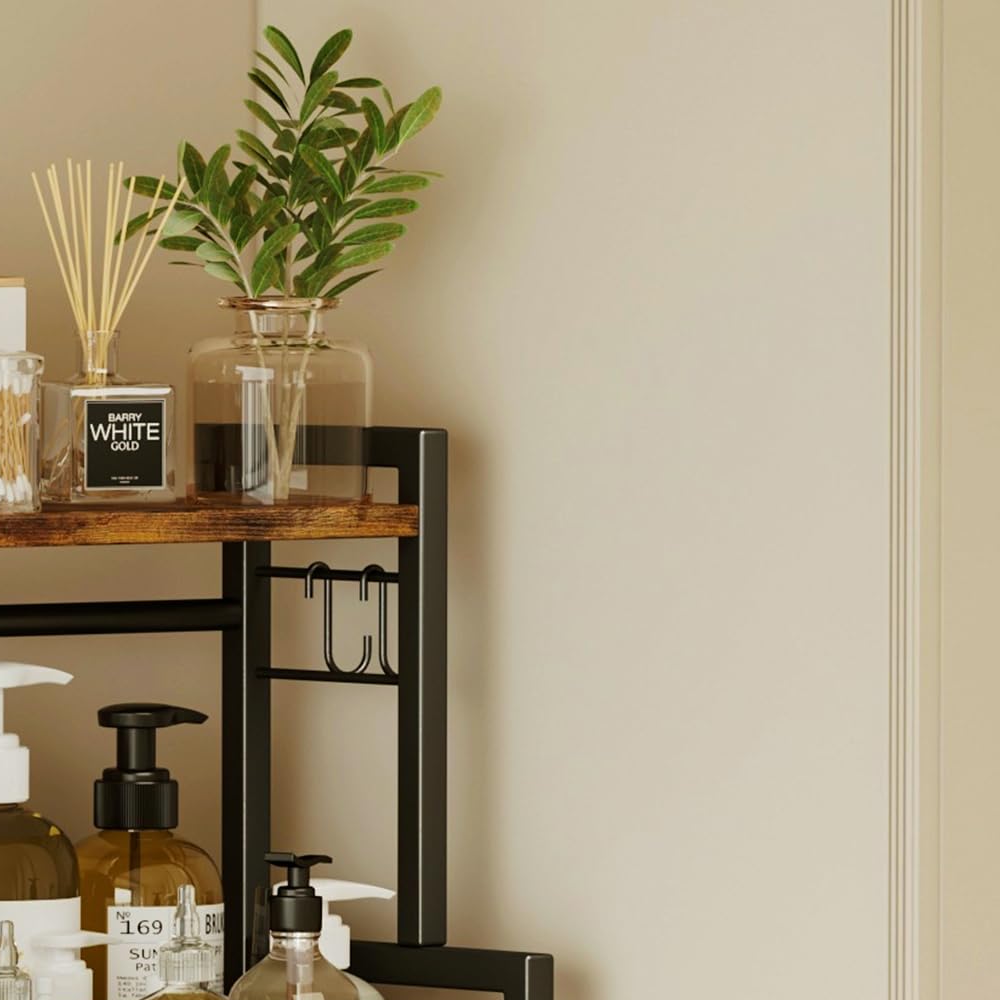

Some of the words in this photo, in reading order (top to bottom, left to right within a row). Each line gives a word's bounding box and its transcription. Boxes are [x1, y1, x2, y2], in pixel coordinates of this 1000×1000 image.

[108, 413, 142, 422] BARRY
[90, 422, 160, 441] WHITE
[110, 441, 140, 451] GOLD
[120, 919, 163, 935] 169
